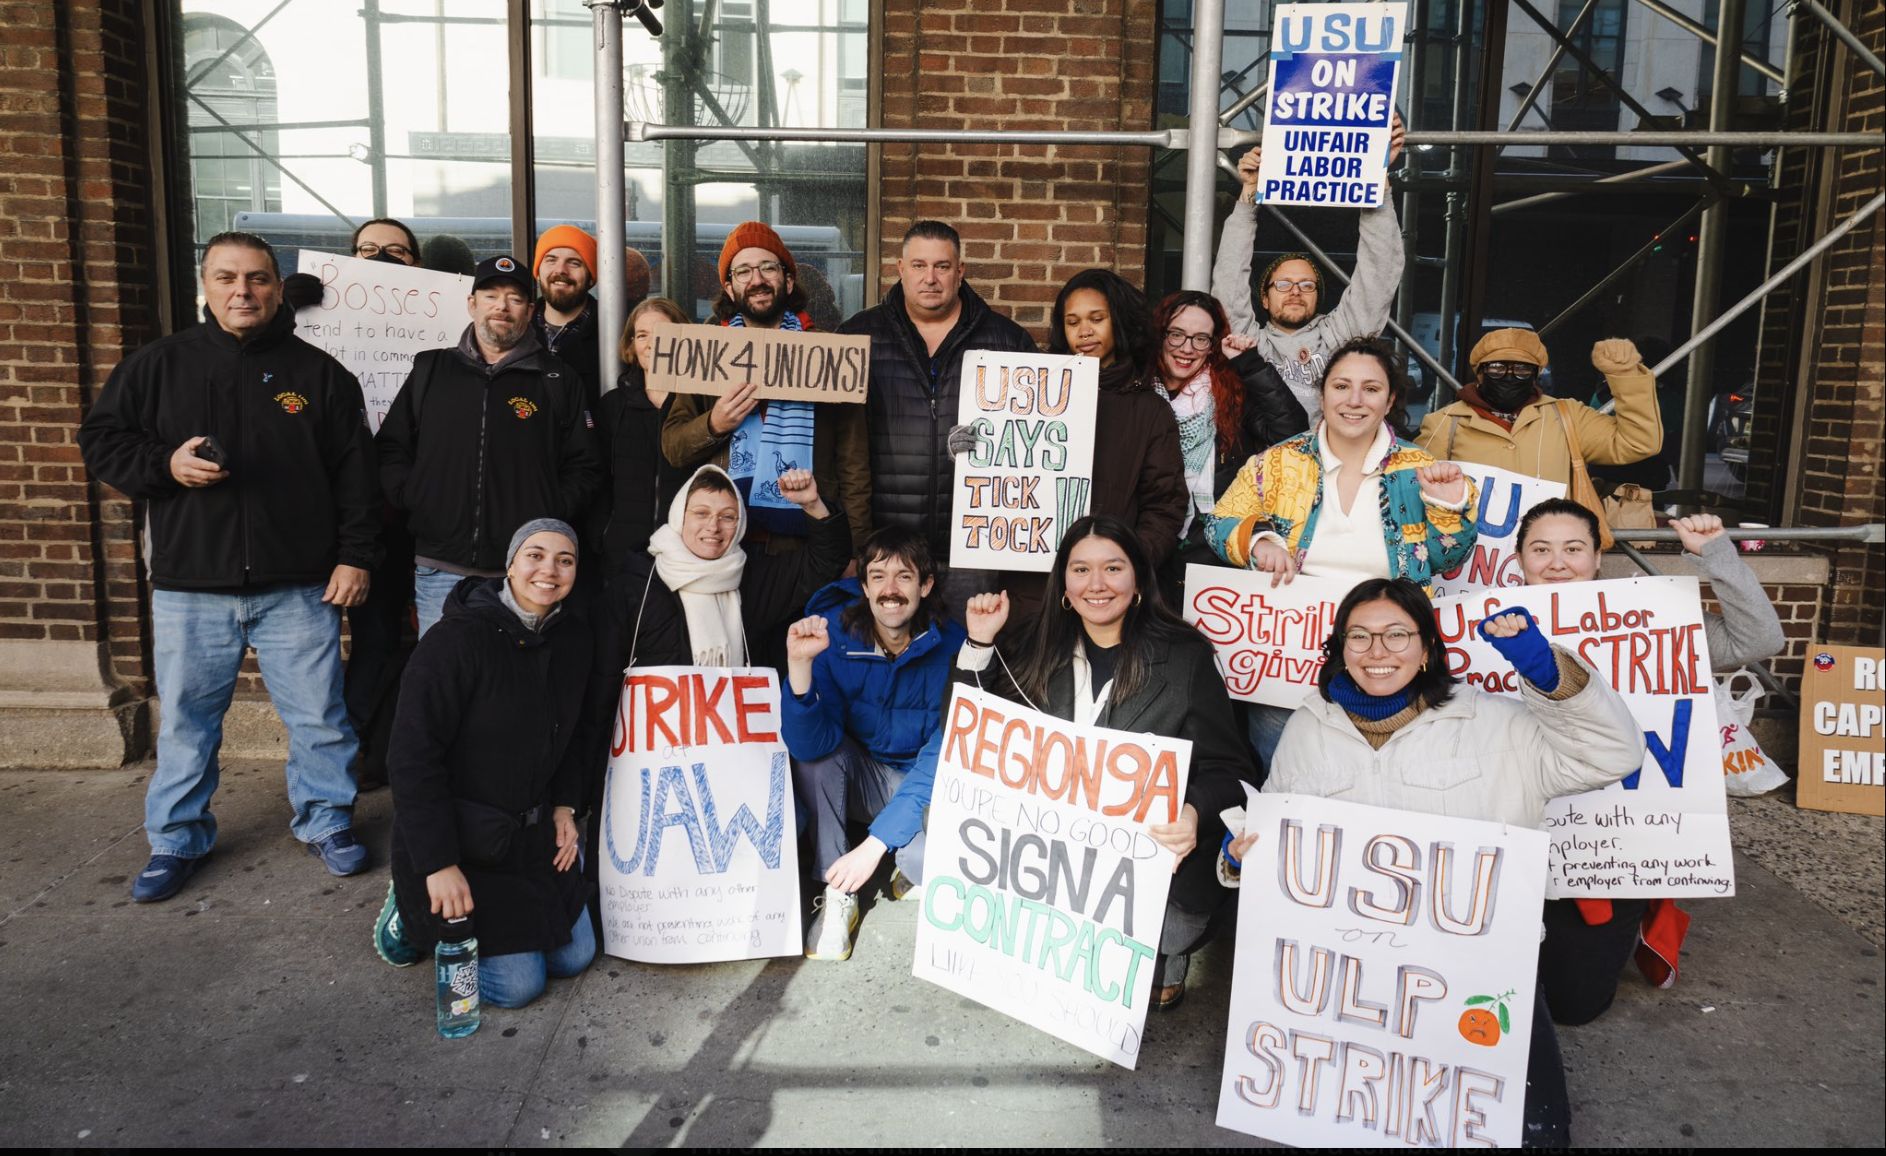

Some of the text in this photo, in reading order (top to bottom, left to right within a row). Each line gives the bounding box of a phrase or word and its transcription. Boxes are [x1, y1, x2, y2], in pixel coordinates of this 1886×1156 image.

[1281, 13, 1395, 52] USU
[1311, 59, 1357, 88] ON
[1274, 92, 1387, 121] STRIKE
[1284, 130, 1370, 153] UNFAIR
[1285, 155, 1362, 178] LABOR
[1265, 179, 1378, 204] PRACTICE
[303, 320, 448, 341] tend to have a
[354, 347, 366, 361] in
[652, 336, 867, 394] HONK 4 UNIONS!
[976, 365, 1073, 417] USU
[968, 417, 1068, 471] SAYS
[964, 476, 1041, 509] TICK
[962, 514, 1053, 554] TOCK
[1551, 591, 1654, 636] Labor
[612, 674, 778, 758] STRIKE
[1814, 701, 1885, 738] CAP
[663, 743, 692, 759] at
[605, 751, 787, 877] UAW
[1595, 804, 1635, 828] with
[1645, 812, 1682, 835] any
[1017, 802, 1060, 835] NO
[1070, 818, 1158, 859] GOOD
[1550, 834, 1623, 860] ployer.
[959, 818, 1134, 938] SIGN A
[1278, 817, 1504, 936] USU
[1562, 855, 1637, 877] preventing
[1641, 857, 1669, 876] any
[1674, 853, 1717, 869] work
[1567, 874, 1626, 890] employer
[1628, 872, 1662, 887] from
[605, 883, 757, 902] No Dispute with any other
[638, 920, 653, 931] not
[765, 911, 786, 924] any
[633, 935, 658, 947] union
[662, 932, 687, 945] from
[925, 875, 1155, 1010] CONTRACT
[1335, 928, 1408, 948] on
[1273, 937, 1448, 1040] ULP
[1235, 1020, 1506, 1148] STRIKE
